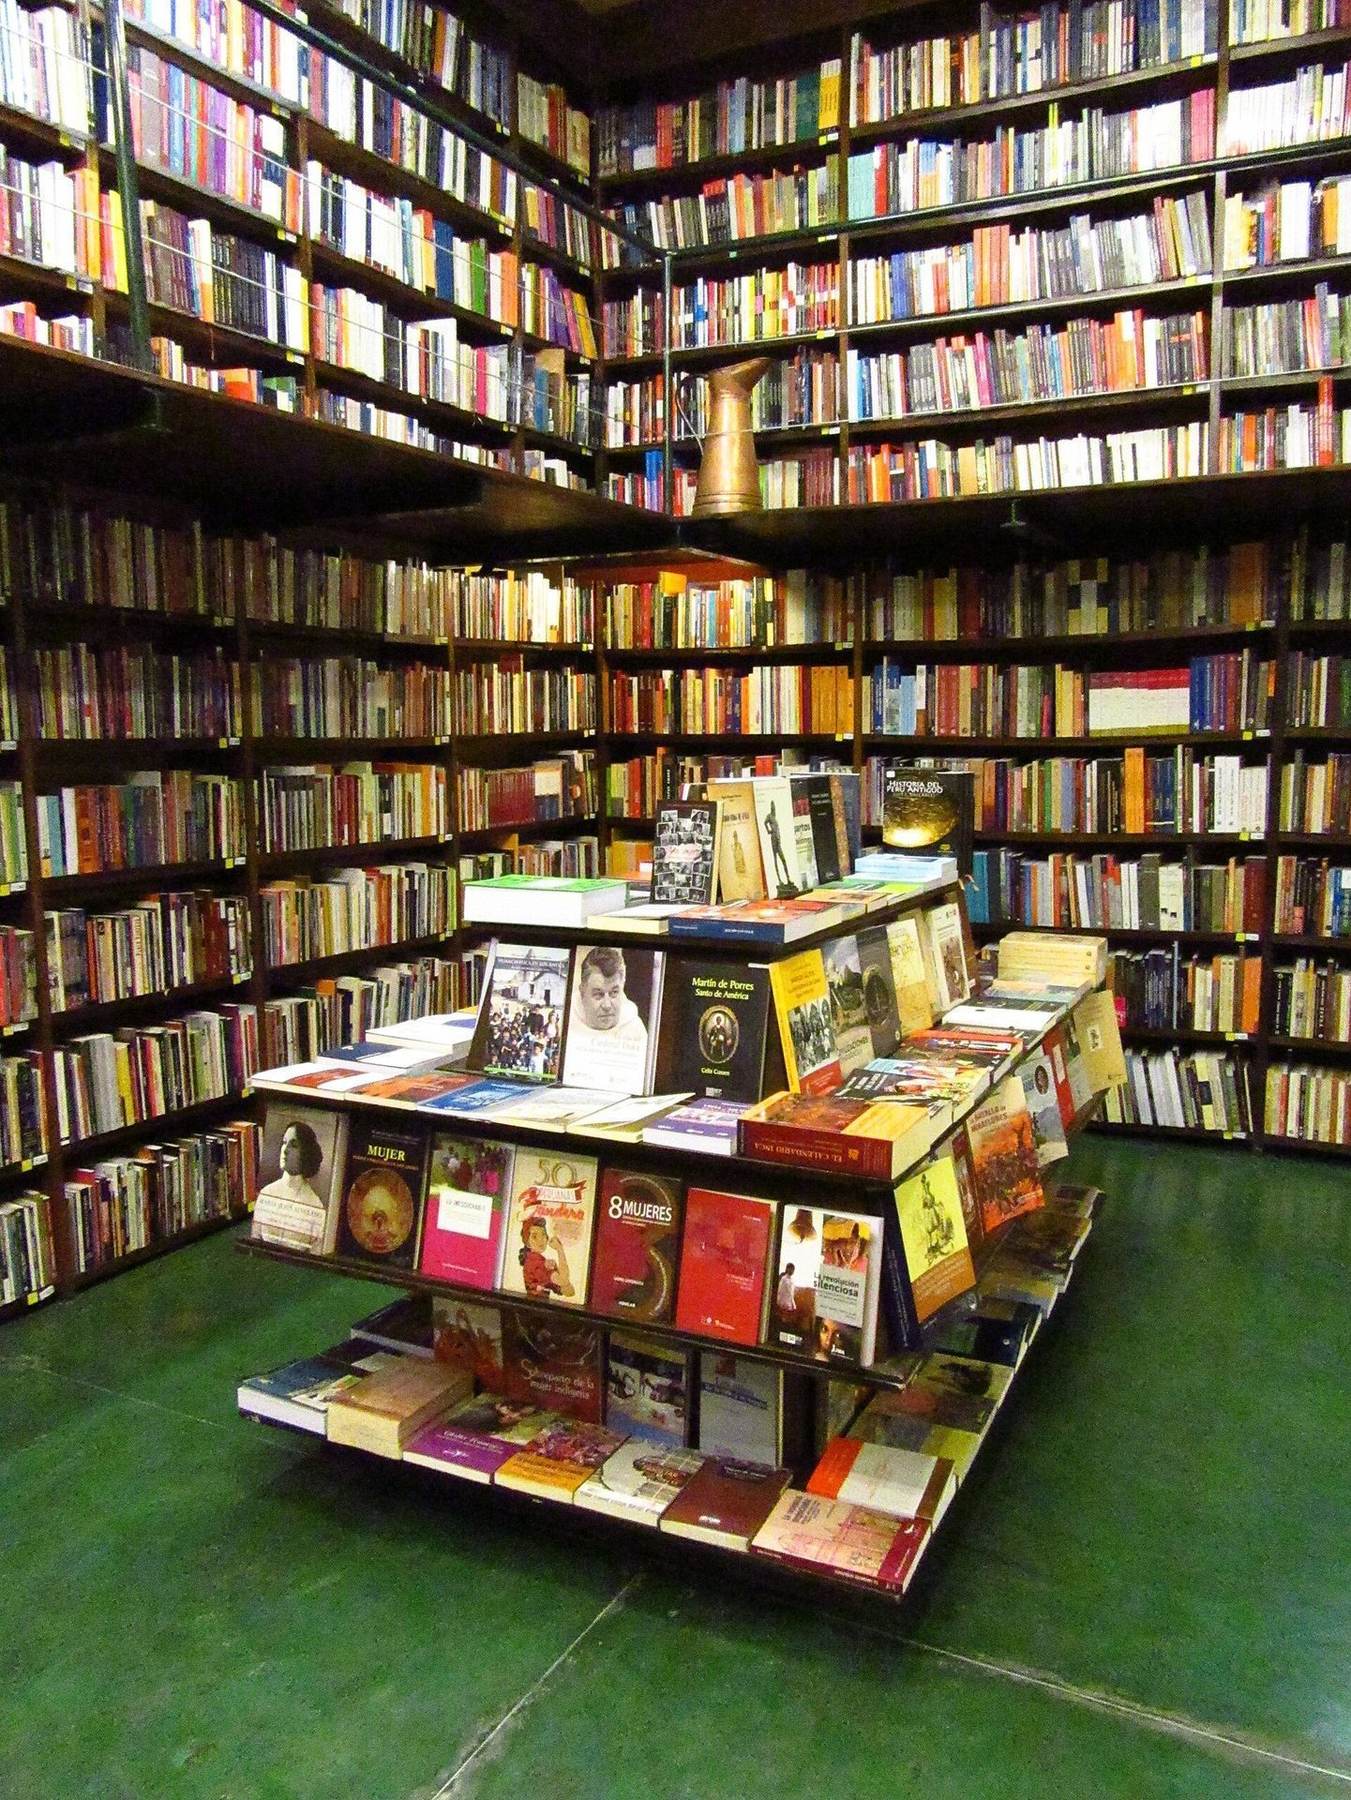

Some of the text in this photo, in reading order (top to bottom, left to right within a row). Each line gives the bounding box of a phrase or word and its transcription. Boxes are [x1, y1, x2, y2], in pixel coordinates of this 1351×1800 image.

[907, 785, 944, 794] ANTIGUO
[695, 988, 713, 997] Santo
[713, 989, 722, 997] de
[718, 979, 728, 989] de
[730, 980, 754, 991] Porres
[367, 1144, 406, 1162] MUJER
[754, 1142, 843, 1163] EL CALENDARIO INCA
[608, 1195, 623, 1219] 8
[623, 1200, 673, 1222] MUJERES
[813, 1279, 859, 1297] silenciosa
